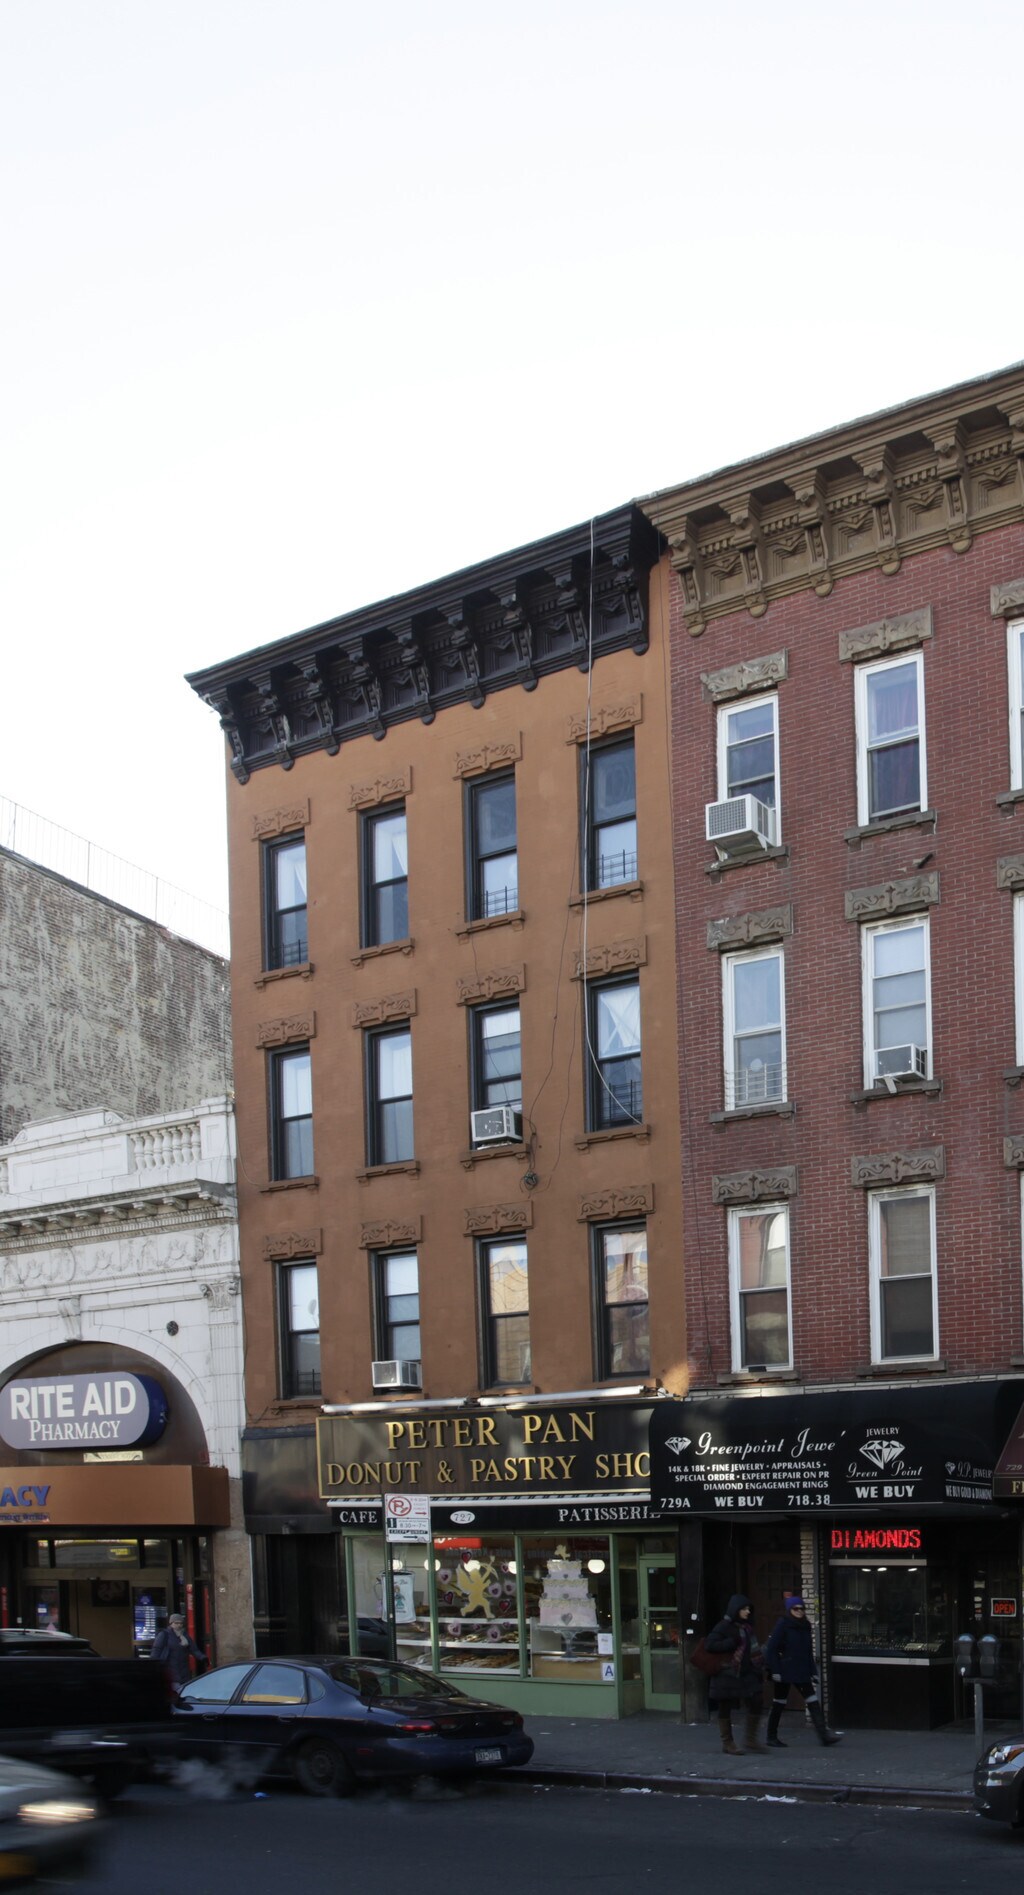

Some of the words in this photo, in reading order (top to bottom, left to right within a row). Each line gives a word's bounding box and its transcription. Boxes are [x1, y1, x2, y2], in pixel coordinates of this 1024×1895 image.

[10, 1384, 74, 1420] RITE
[82, 1380, 136, 1416] AID
[29, 1420, 120, 1442] PHARMACY
[385, 1416, 500, 1450] PETER
[522, 1412, 596, 1444] PAN
[866, 1427, 900, 1437] JEWELRY
[695, 1432, 784, 1460] Greenpoint
[327, 1461, 421, 1485] DONUT
[437, 1460, 455, 1483] &
[471, 1455, 576, 1482] PASTRY
[712, 1464, 730, 1472] FINE
[731, 1463, 764, 1472] JEWELRY
[772, 1461, 821, 1470] APPRAISALS
[846, 1462, 878, 1478] Green
[891, 1460, 922, 1476] Point
[675, 1474, 706, 1482] SPECIAL
[708, 1473, 735, 1481] ORDER
[742, 1472, 770, 1480] EXPERT
[704, 1483, 743, 1491] DIAMOND
[745, 1482, 801, 1490] ENGAGEMENT
[855, 1486, 878, 1498] WE
[883, 1485, 915, 1498] BUY
[0, 1485, 50, 1506] ACY
[660, 1498, 690, 1508] 729A
[714, 1496, 734, 1507] WE
[737, 1496, 764, 1507] BUY
[339, 1511, 378, 1524] CAFE
[454, 1513, 472, 1522] 727
[831, 1529, 921, 1549] DIAMONDS
[994, 1603, 1015, 1614] OPEN
[605, 1665, 613, 1676] A
